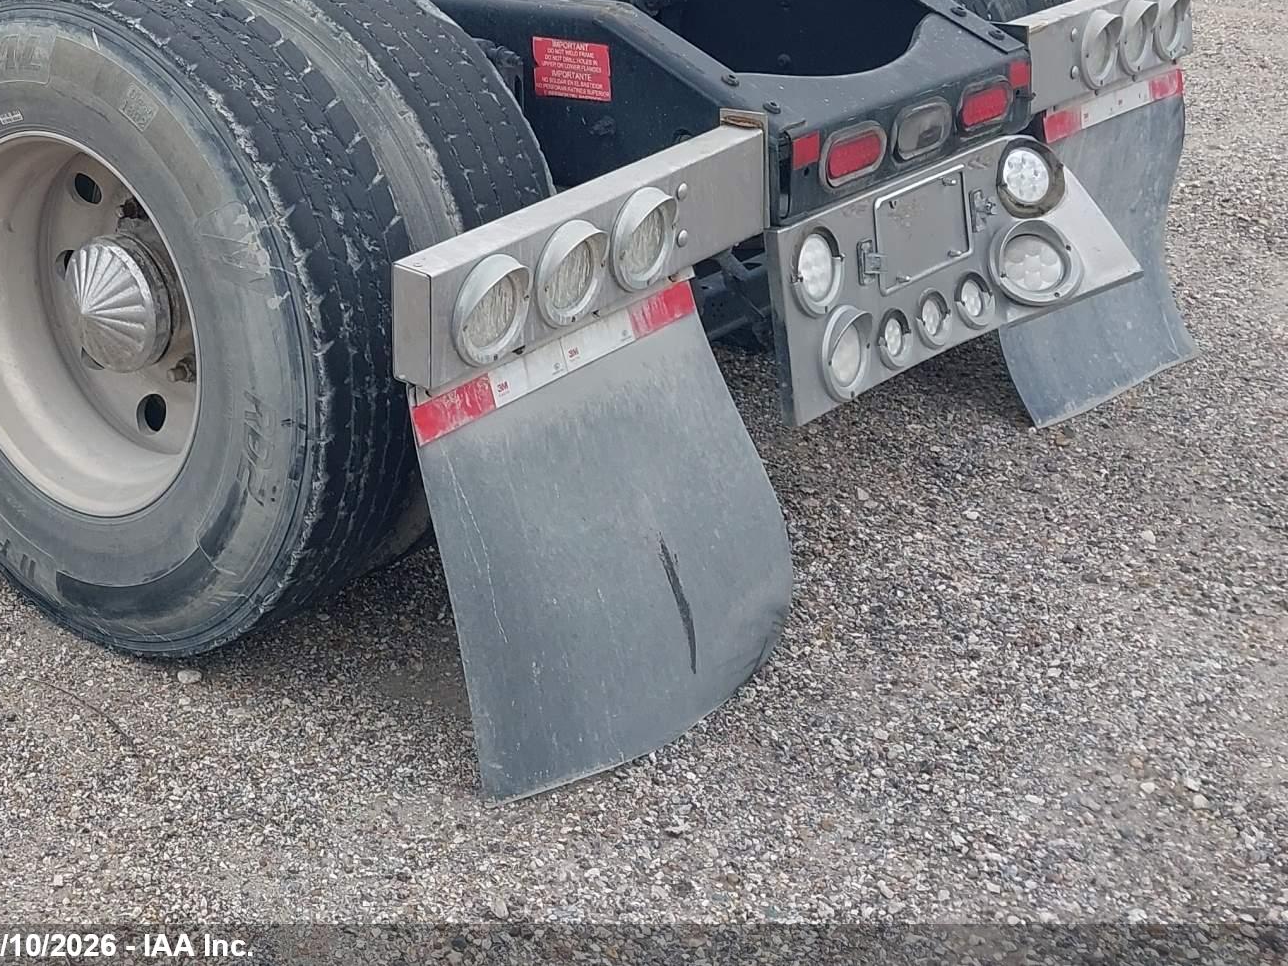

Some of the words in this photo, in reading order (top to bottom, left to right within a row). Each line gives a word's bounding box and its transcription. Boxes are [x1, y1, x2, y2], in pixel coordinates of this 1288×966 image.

[551, 39, 588, 51] IMPORTANT
[551, 69, 591, 81] IMPORTANTE
[568, 347, 580, 358] 3M
[497, 381, 509, 392] 3M
